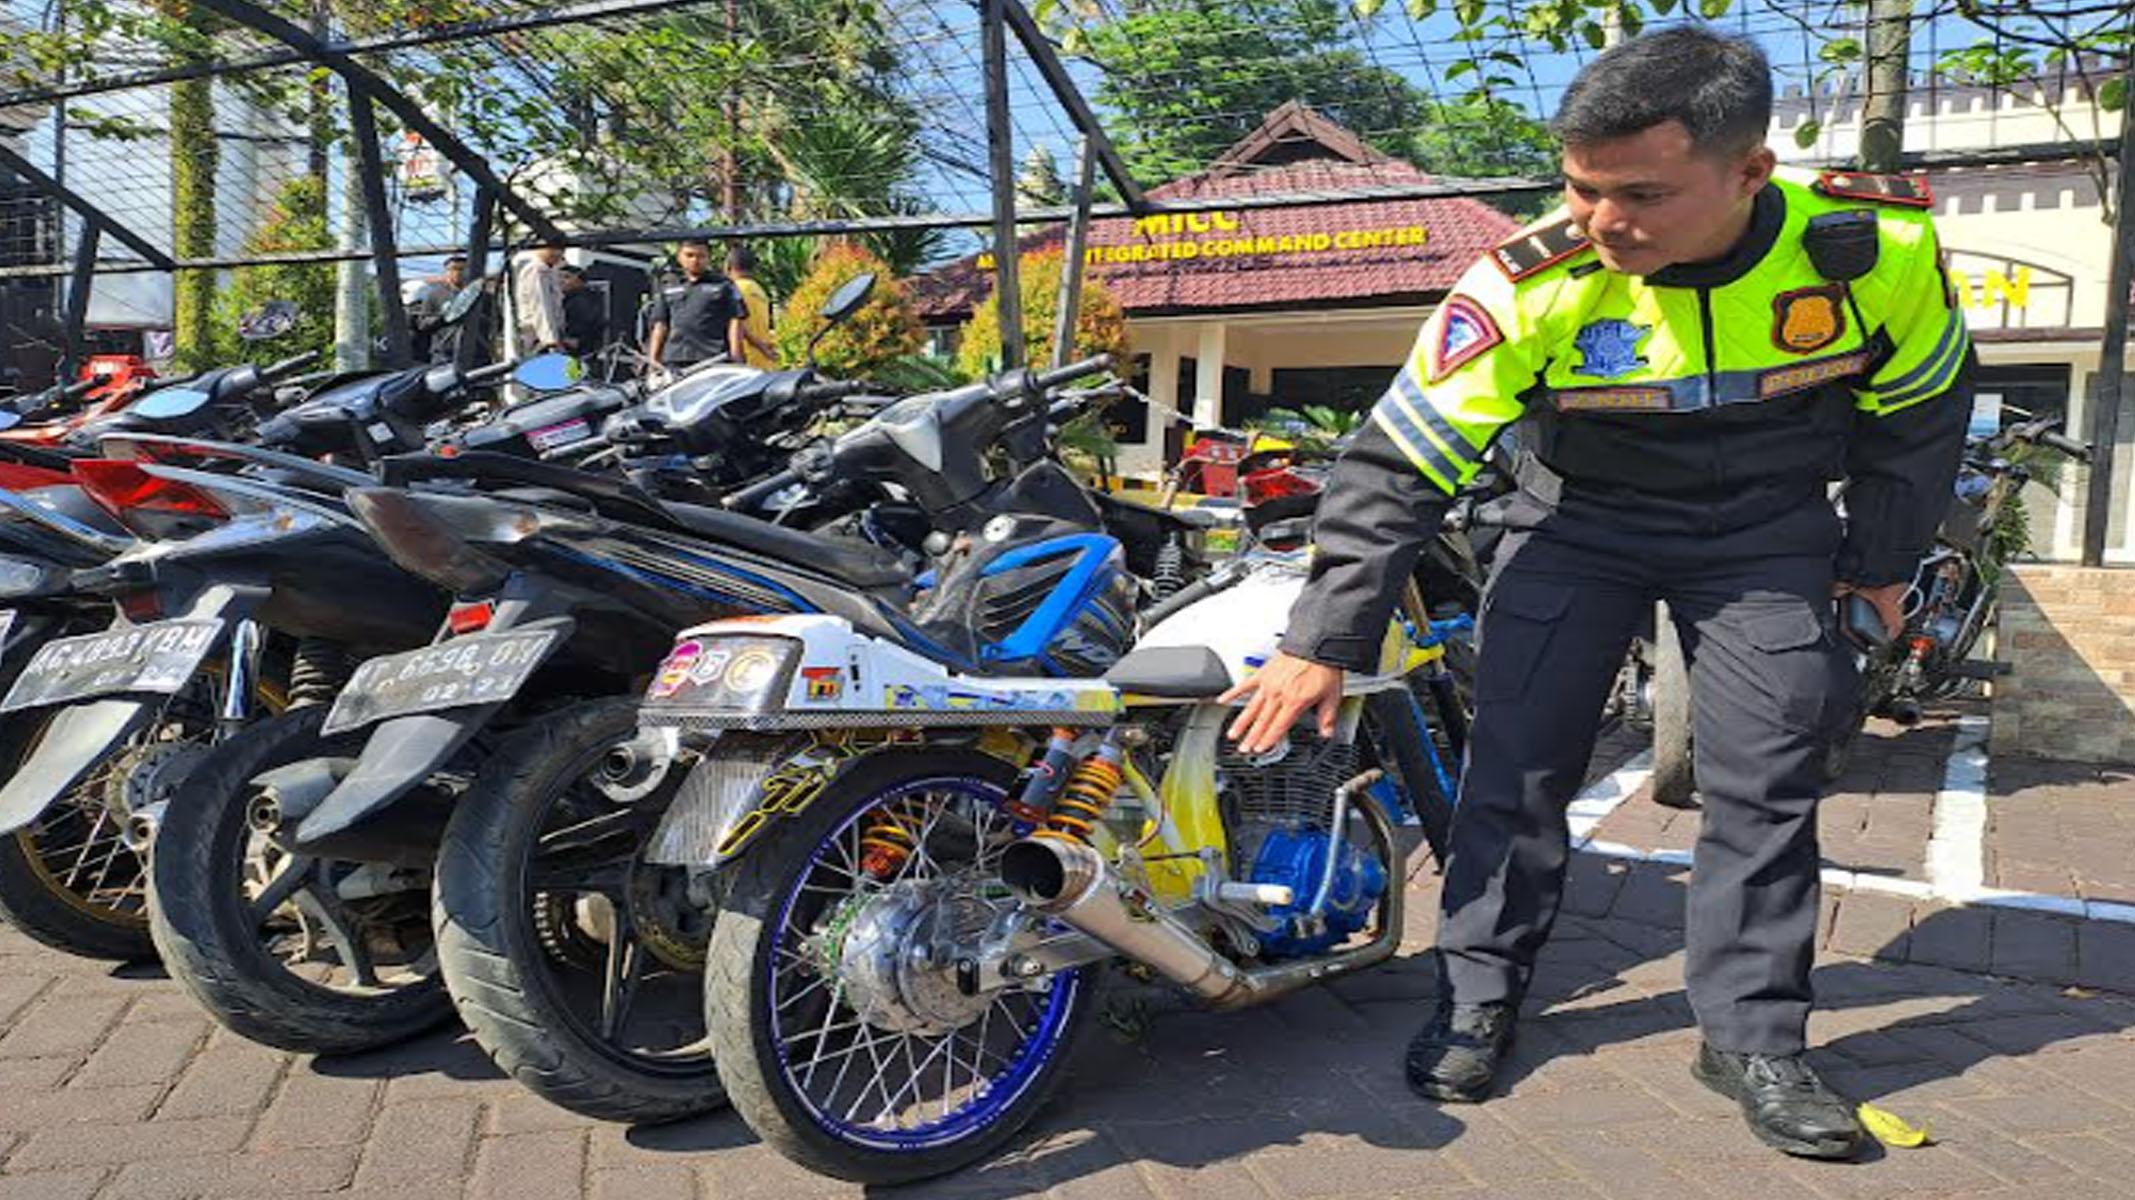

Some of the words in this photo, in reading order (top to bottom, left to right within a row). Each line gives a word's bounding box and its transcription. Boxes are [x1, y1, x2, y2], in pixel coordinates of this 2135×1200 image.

[1085, 241, 1197, 264] TEGRATED
[1203, 232, 1331, 258] COMMAND
[1334, 225, 1425, 250] CENTER
